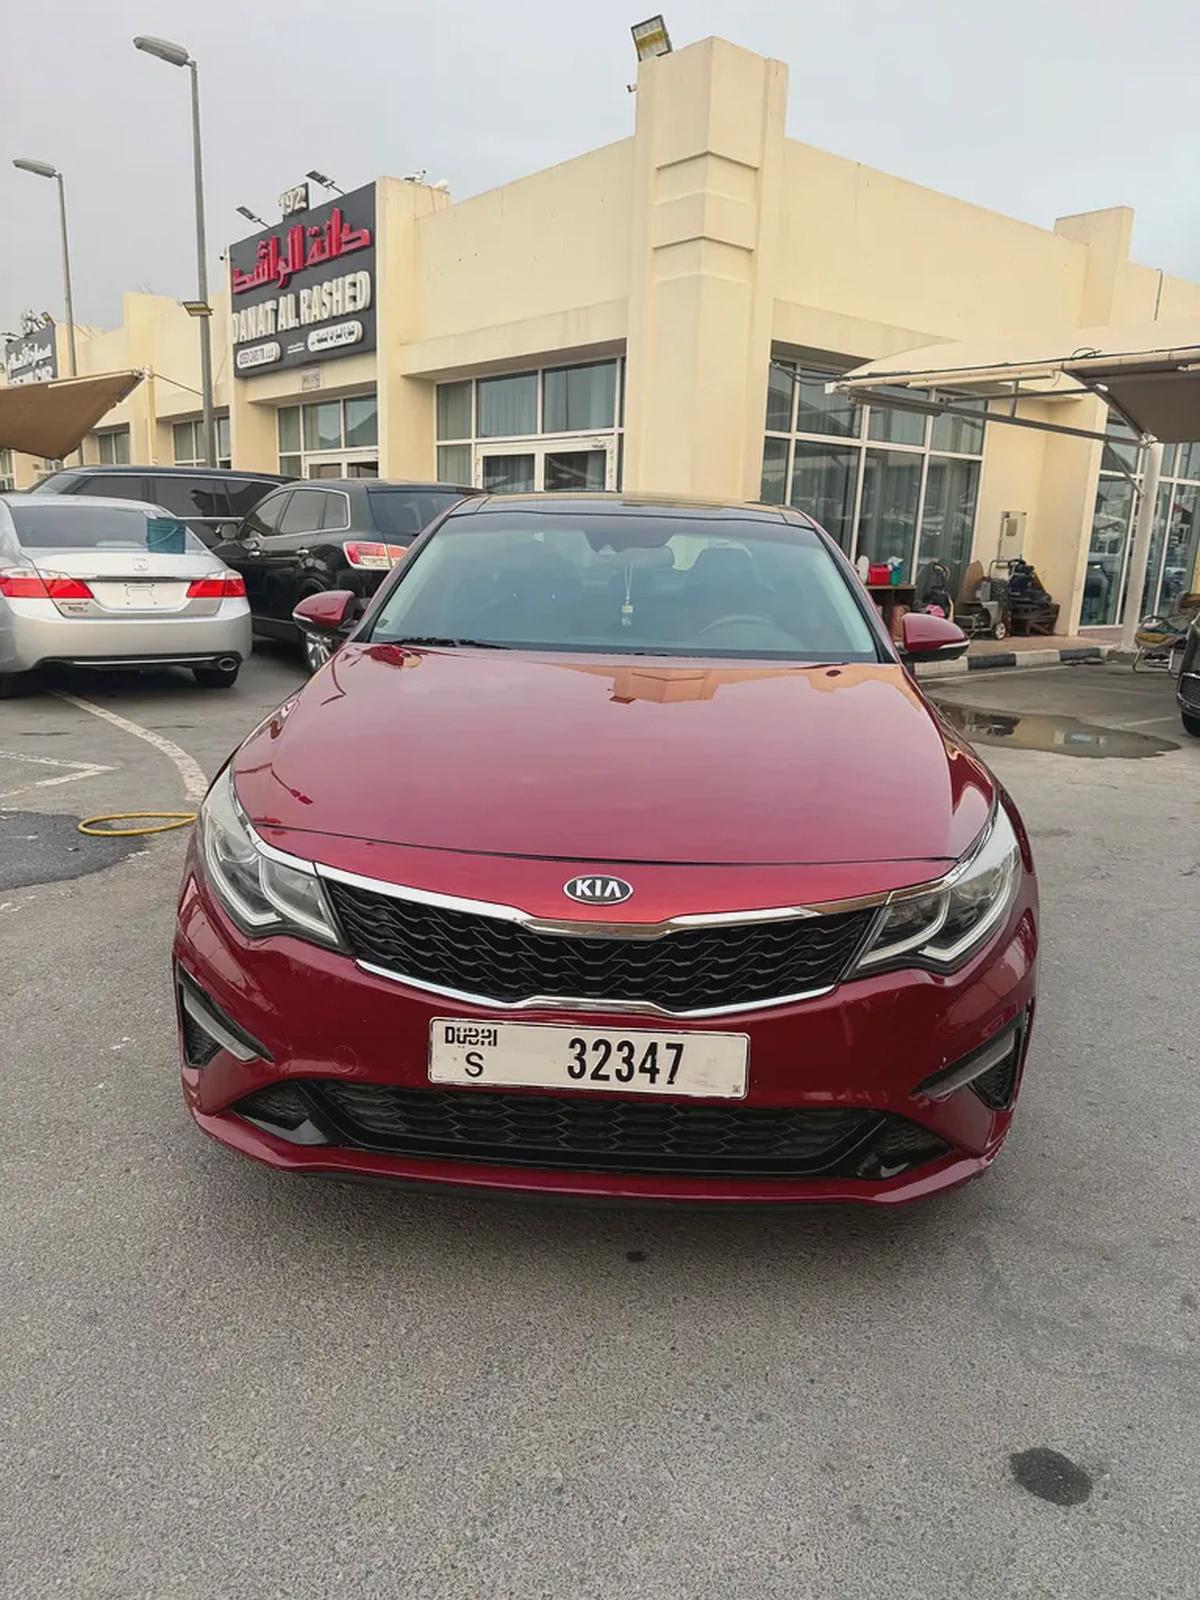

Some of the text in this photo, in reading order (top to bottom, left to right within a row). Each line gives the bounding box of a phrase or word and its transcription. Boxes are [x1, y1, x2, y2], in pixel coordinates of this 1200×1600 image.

[231, 299, 277, 345] DANAT
[278, 293, 300, 331] AL
[300, 270, 371, 325] RASHED
[576, 879, 622, 897] KIA
[465, 1051, 484, 1077] S
[567, 1038, 684, 1085] 32347
